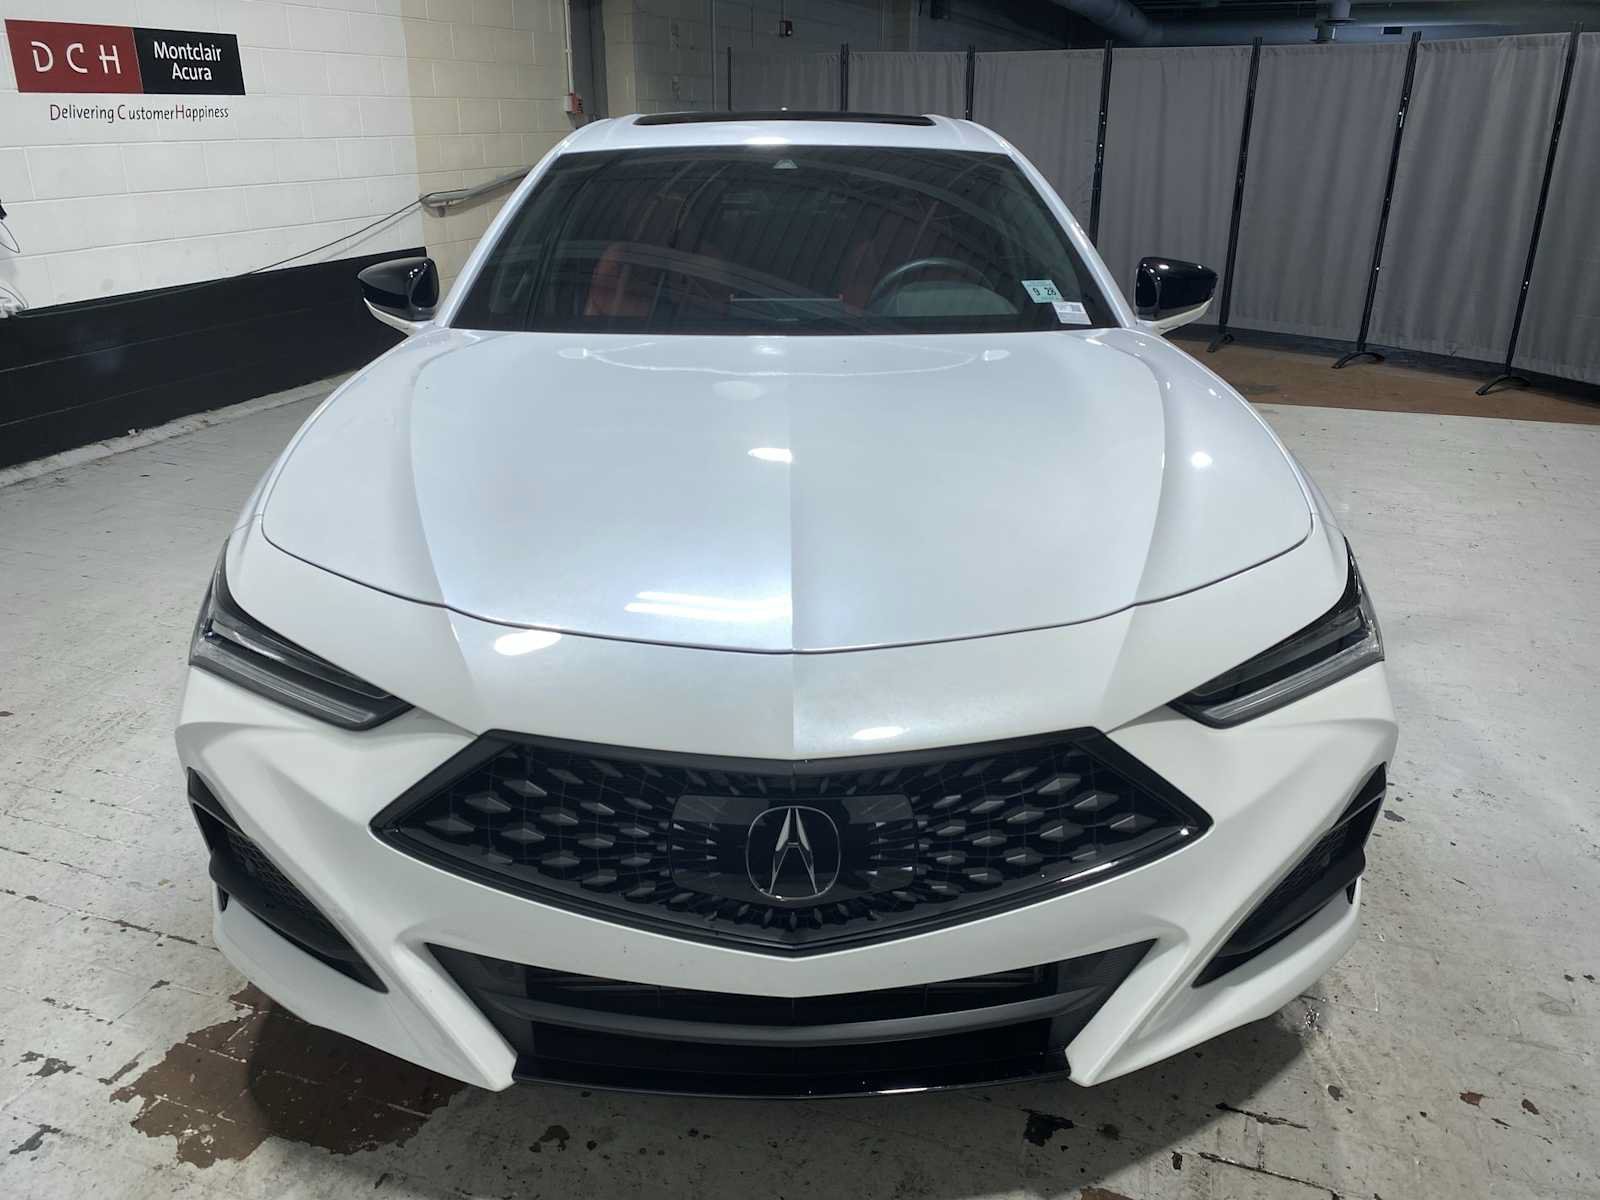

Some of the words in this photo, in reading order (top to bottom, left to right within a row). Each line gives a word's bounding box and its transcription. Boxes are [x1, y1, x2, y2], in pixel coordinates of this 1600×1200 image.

[31, 40, 121, 75] DCH
[153, 40, 222, 62] Montclair
[171, 63, 213, 81] Acura
[50, 104, 114, 123] Delivering
[175, 104, 229, 122] Happiness
[1032, 287, 1041, 296] 9
